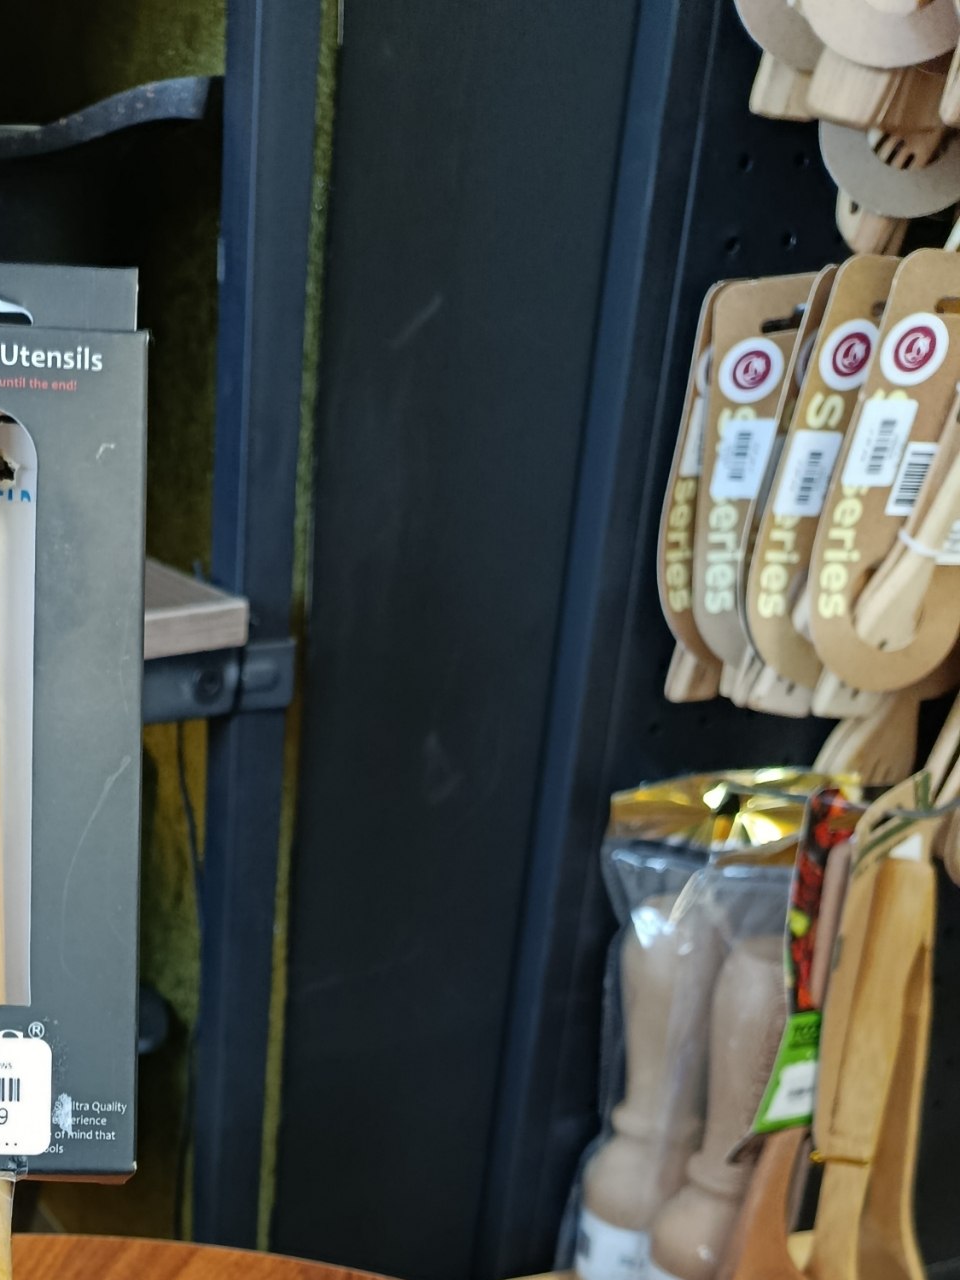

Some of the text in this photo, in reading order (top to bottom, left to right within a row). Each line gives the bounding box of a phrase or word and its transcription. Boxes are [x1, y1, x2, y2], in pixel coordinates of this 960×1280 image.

[0, 344, 103, 372] Utensils
[0, 377, 26, 389] until
[29, 378, 48, 390] the
[51, 380, 77, 392] end!
[704, 497, 743, 614] eries
[92, 1101, 127, 1115] Quality
[68, 1130, 93, 1140] mind
[95, 1130, 116, 1140] that
